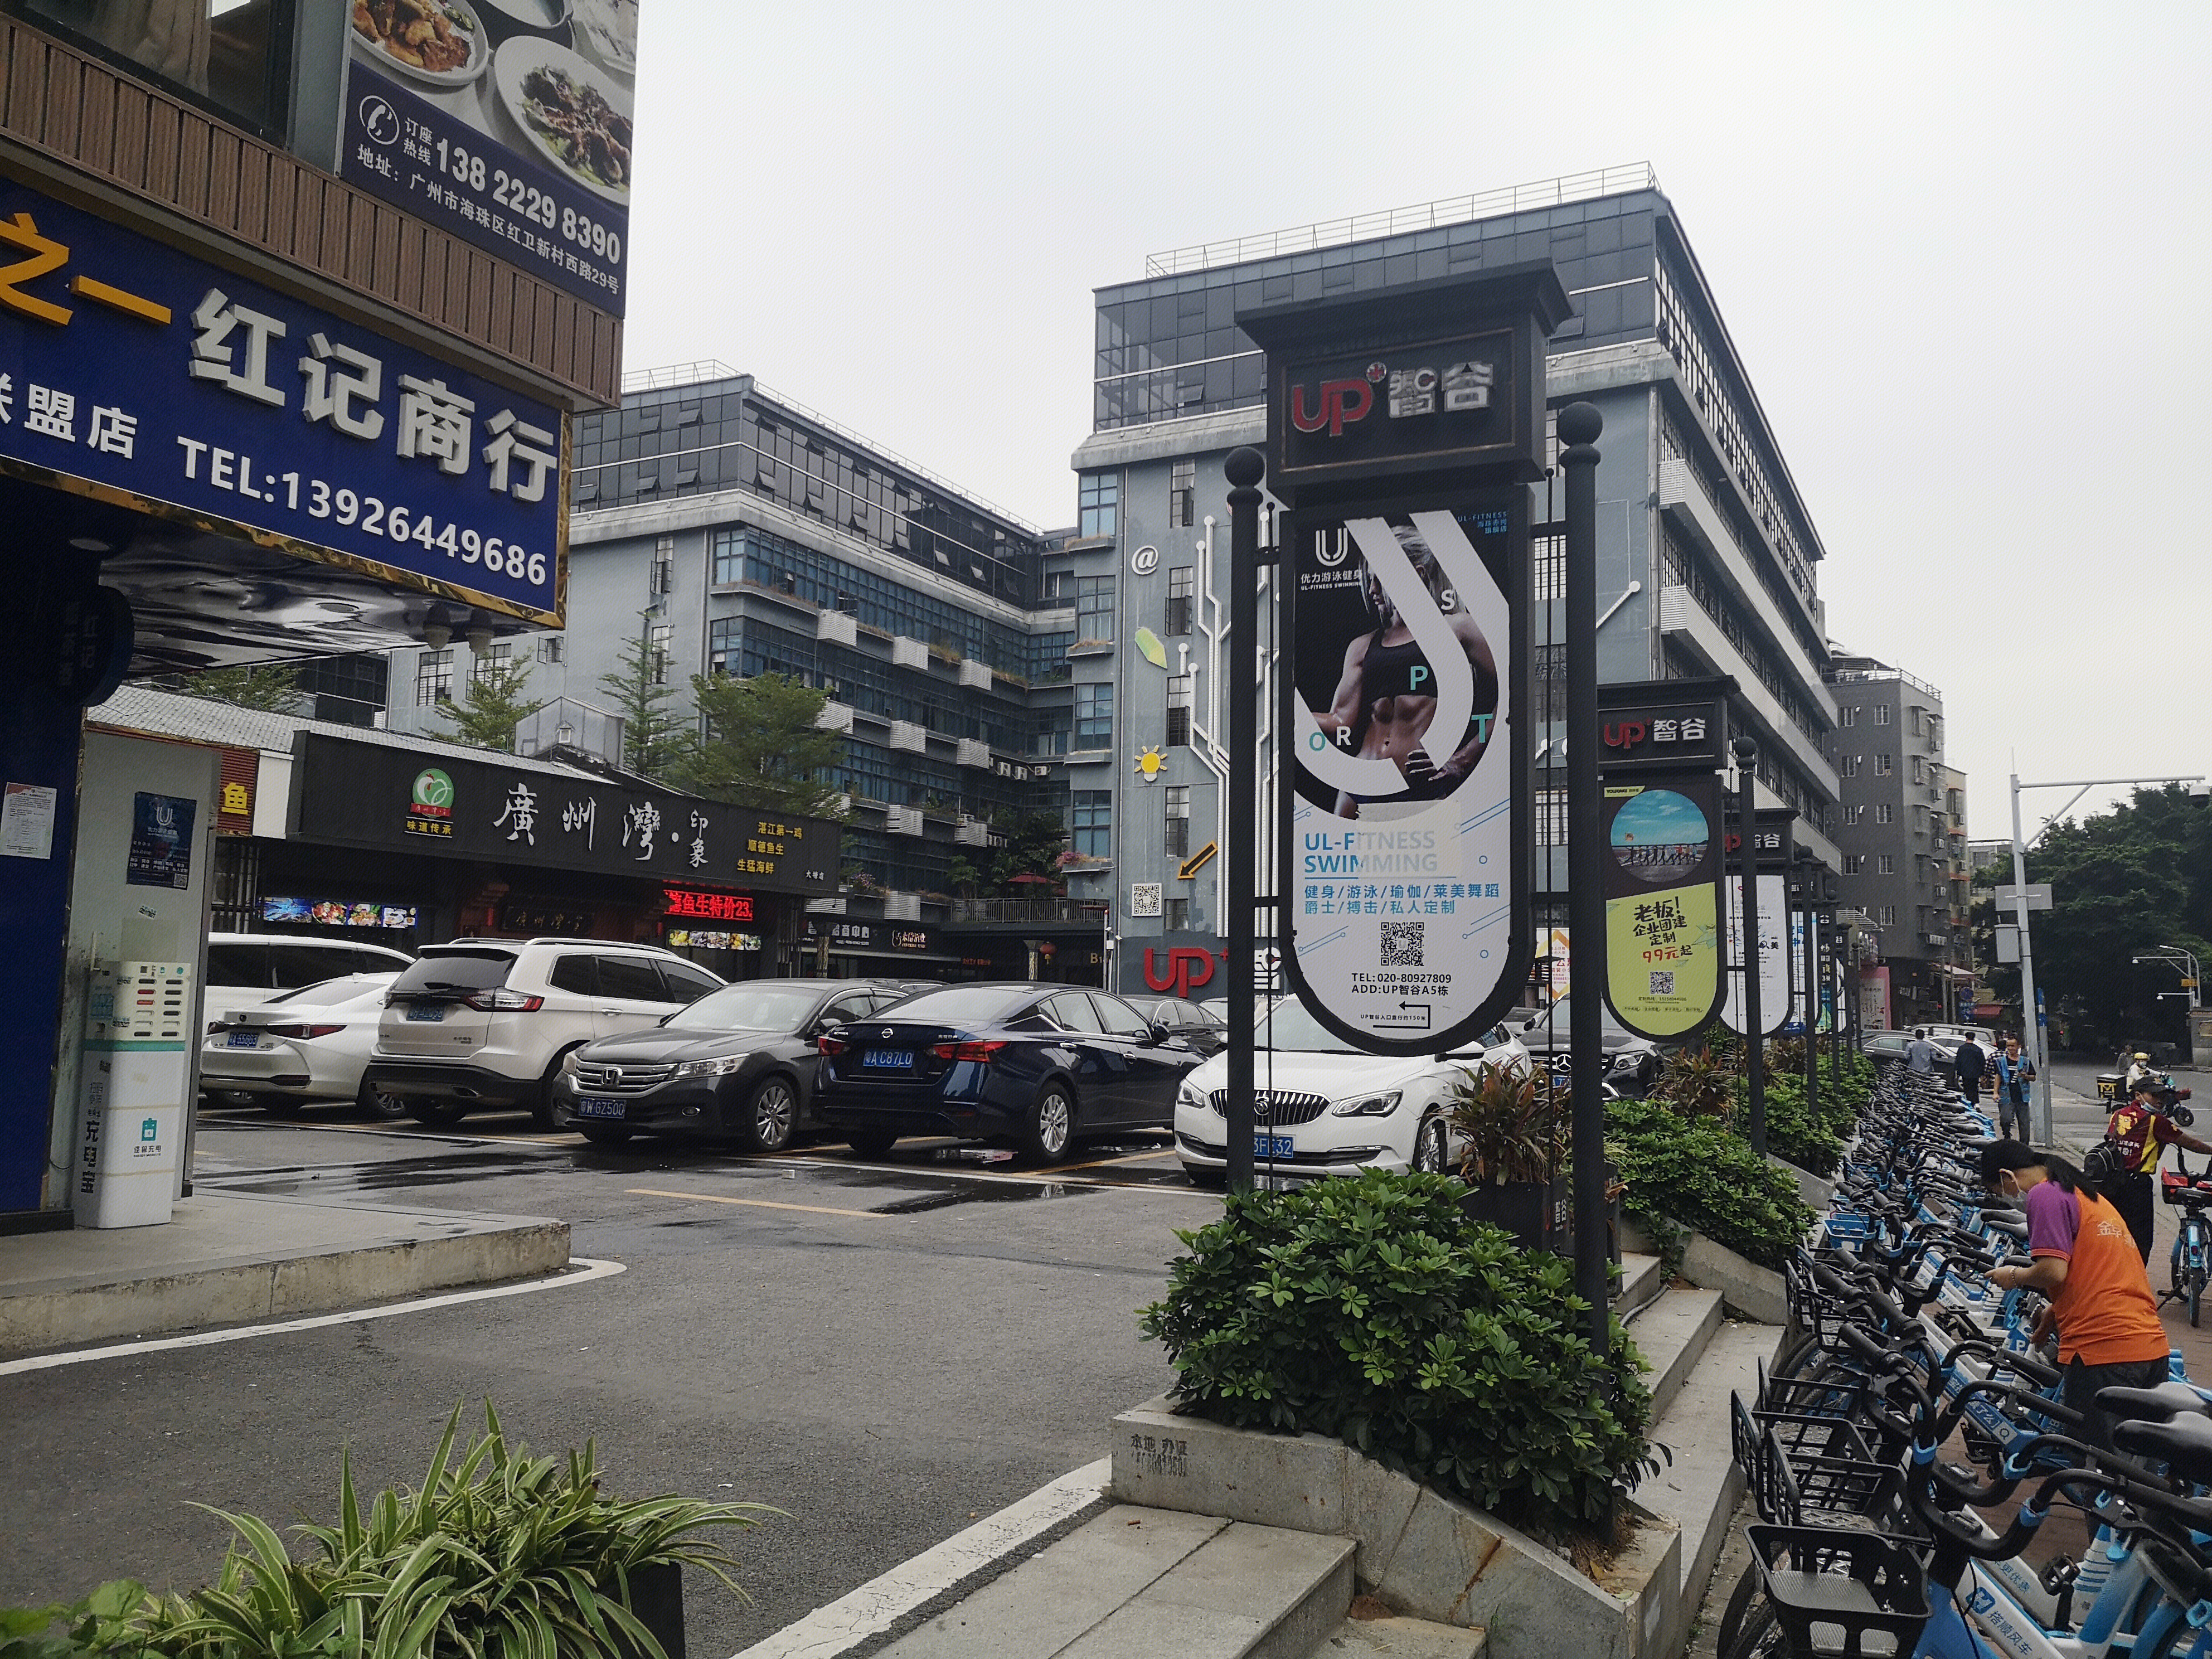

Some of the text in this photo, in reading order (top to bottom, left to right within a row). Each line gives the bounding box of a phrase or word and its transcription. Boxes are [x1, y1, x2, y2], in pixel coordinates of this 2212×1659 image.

[404, 118, 433, 147] 订座
[403, 138, 431, 166] 热线
[435, 139, 622, 264] 138 2229 8390
[189, 287, 557, 502] 红记商行
[1388, 361, 1493, 419] 智谷
[177, 435, 547, 586] TEL:13926449686
[1301, 569, 1362, 584] 优力游泳健身
[1653, 718, 1706, 742] 智谷
[221, 782, 249, 814] 鱼
[406, 819, 452, 835] 味道传承
[748, 838, 784, 856] 顺德鱼生
[1305, 830, 1435, 851] UL-FITNESS
[737, 858, 774, 874] 生猛海鲜
[1305, 853, 1438, 874] SWIMMING
[1632, 914, 1687, 938] 企业团建
[1649, 931, 1676, 947] 定制
[1642, 944, 1694, 964] 99元起
[1986, 1611, 2033, 1657] 搭顺风车
